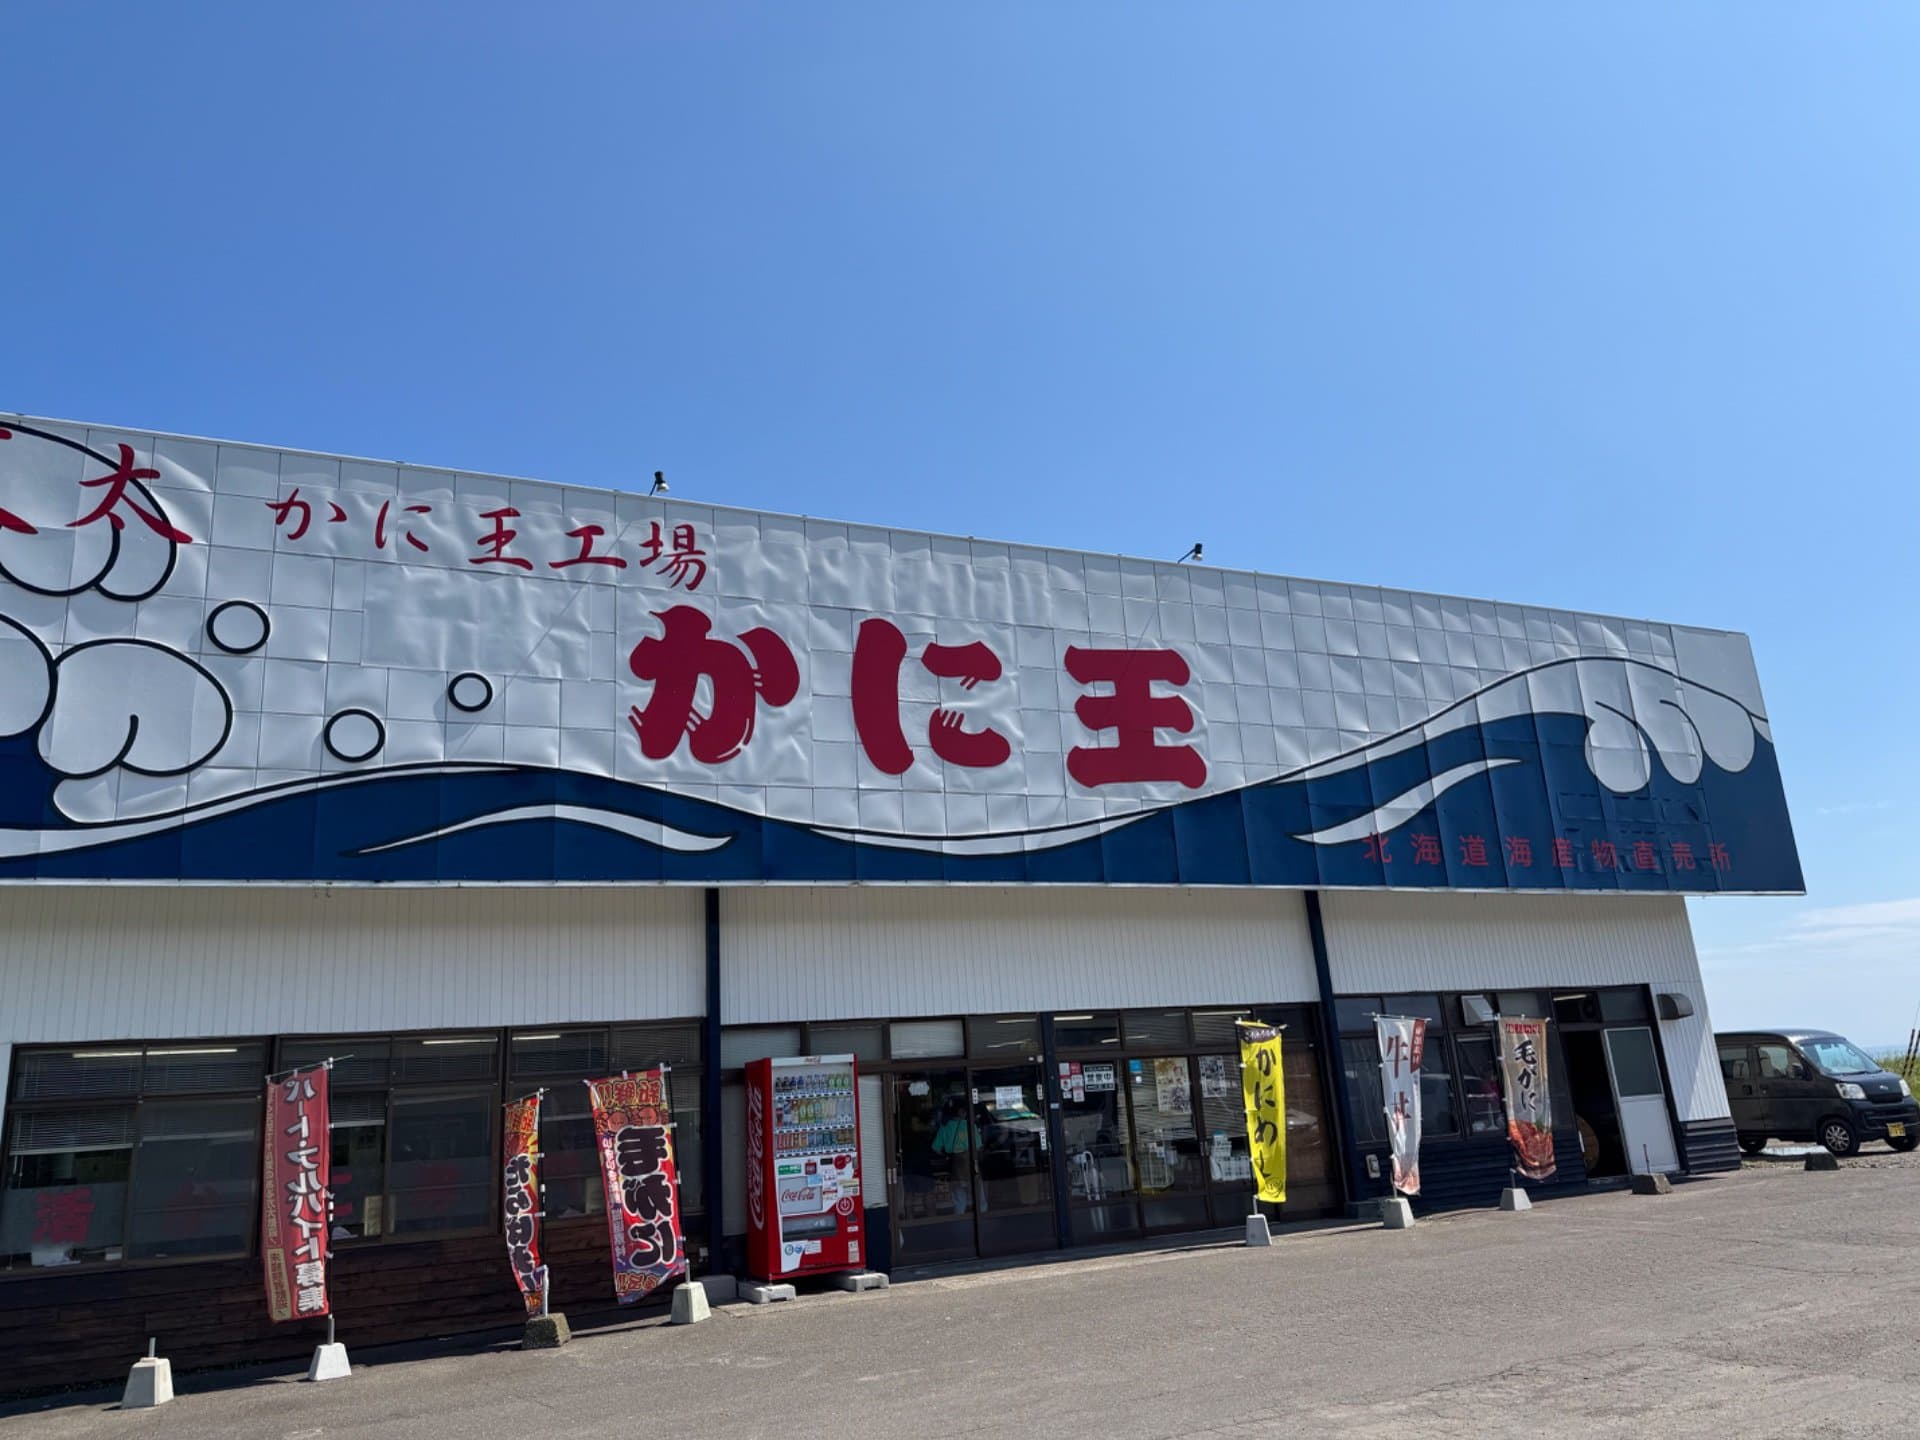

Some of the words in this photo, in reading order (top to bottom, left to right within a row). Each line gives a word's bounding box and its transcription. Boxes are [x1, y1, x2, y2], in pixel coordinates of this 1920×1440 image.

[0, 428, 193, 544] 太
[267, 488, 707, 591] かに王工場
[628, 604, 1207, 789] かに王
[1363, 832, 1731, 870] 北海道海産物直売所
[1514, 1040, 1537, 1111] 毛がに
